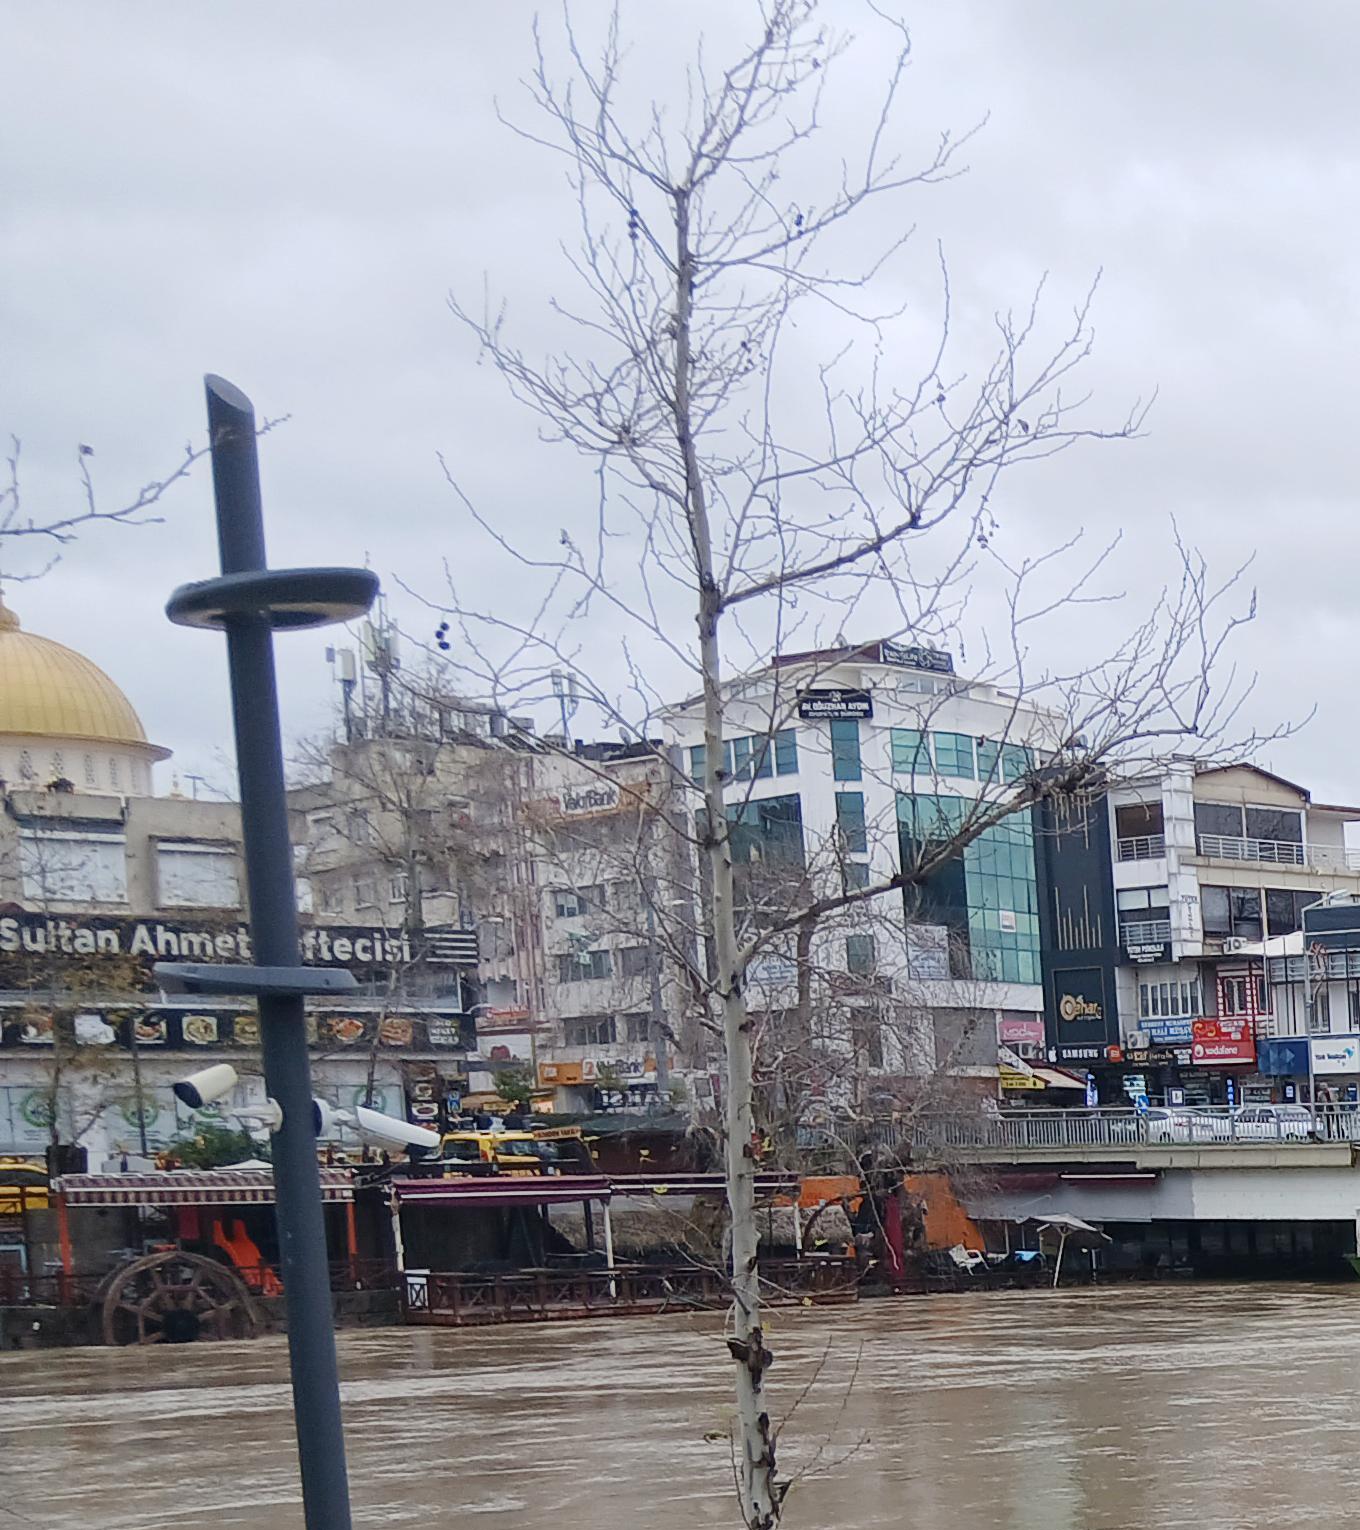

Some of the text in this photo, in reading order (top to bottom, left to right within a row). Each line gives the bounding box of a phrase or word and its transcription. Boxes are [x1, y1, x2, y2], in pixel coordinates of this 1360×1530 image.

[0, 917, 411, 962] Sultan Ahmet ftecisi
[1062, 1049, 1099, 1059] SAMSUNG
[1205, 1045, 1238, 1056] vodafone
